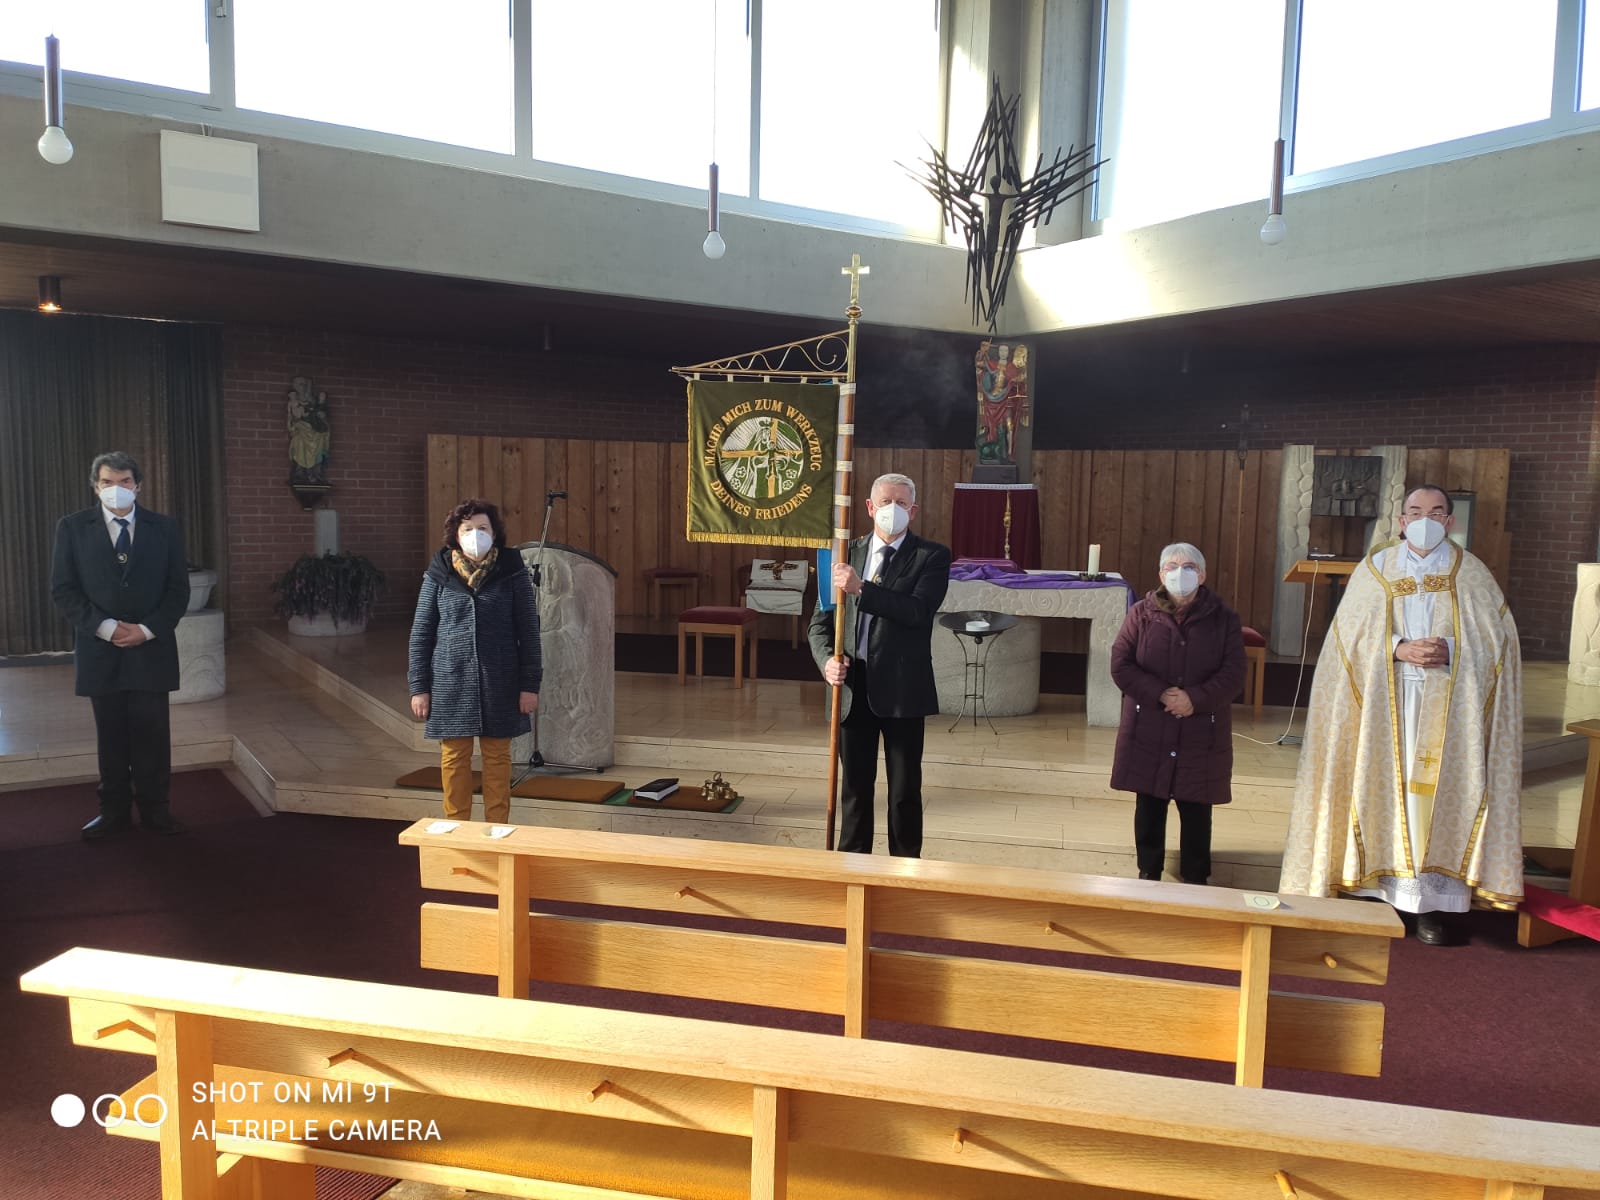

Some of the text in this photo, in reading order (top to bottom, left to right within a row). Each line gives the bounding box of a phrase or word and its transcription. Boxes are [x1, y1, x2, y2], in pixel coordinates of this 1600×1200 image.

[705, 399, 823, 472] MACHE MICH ZUM WERKZEUG
[711, 479, 812, 520] DEINES FRIEDENS
